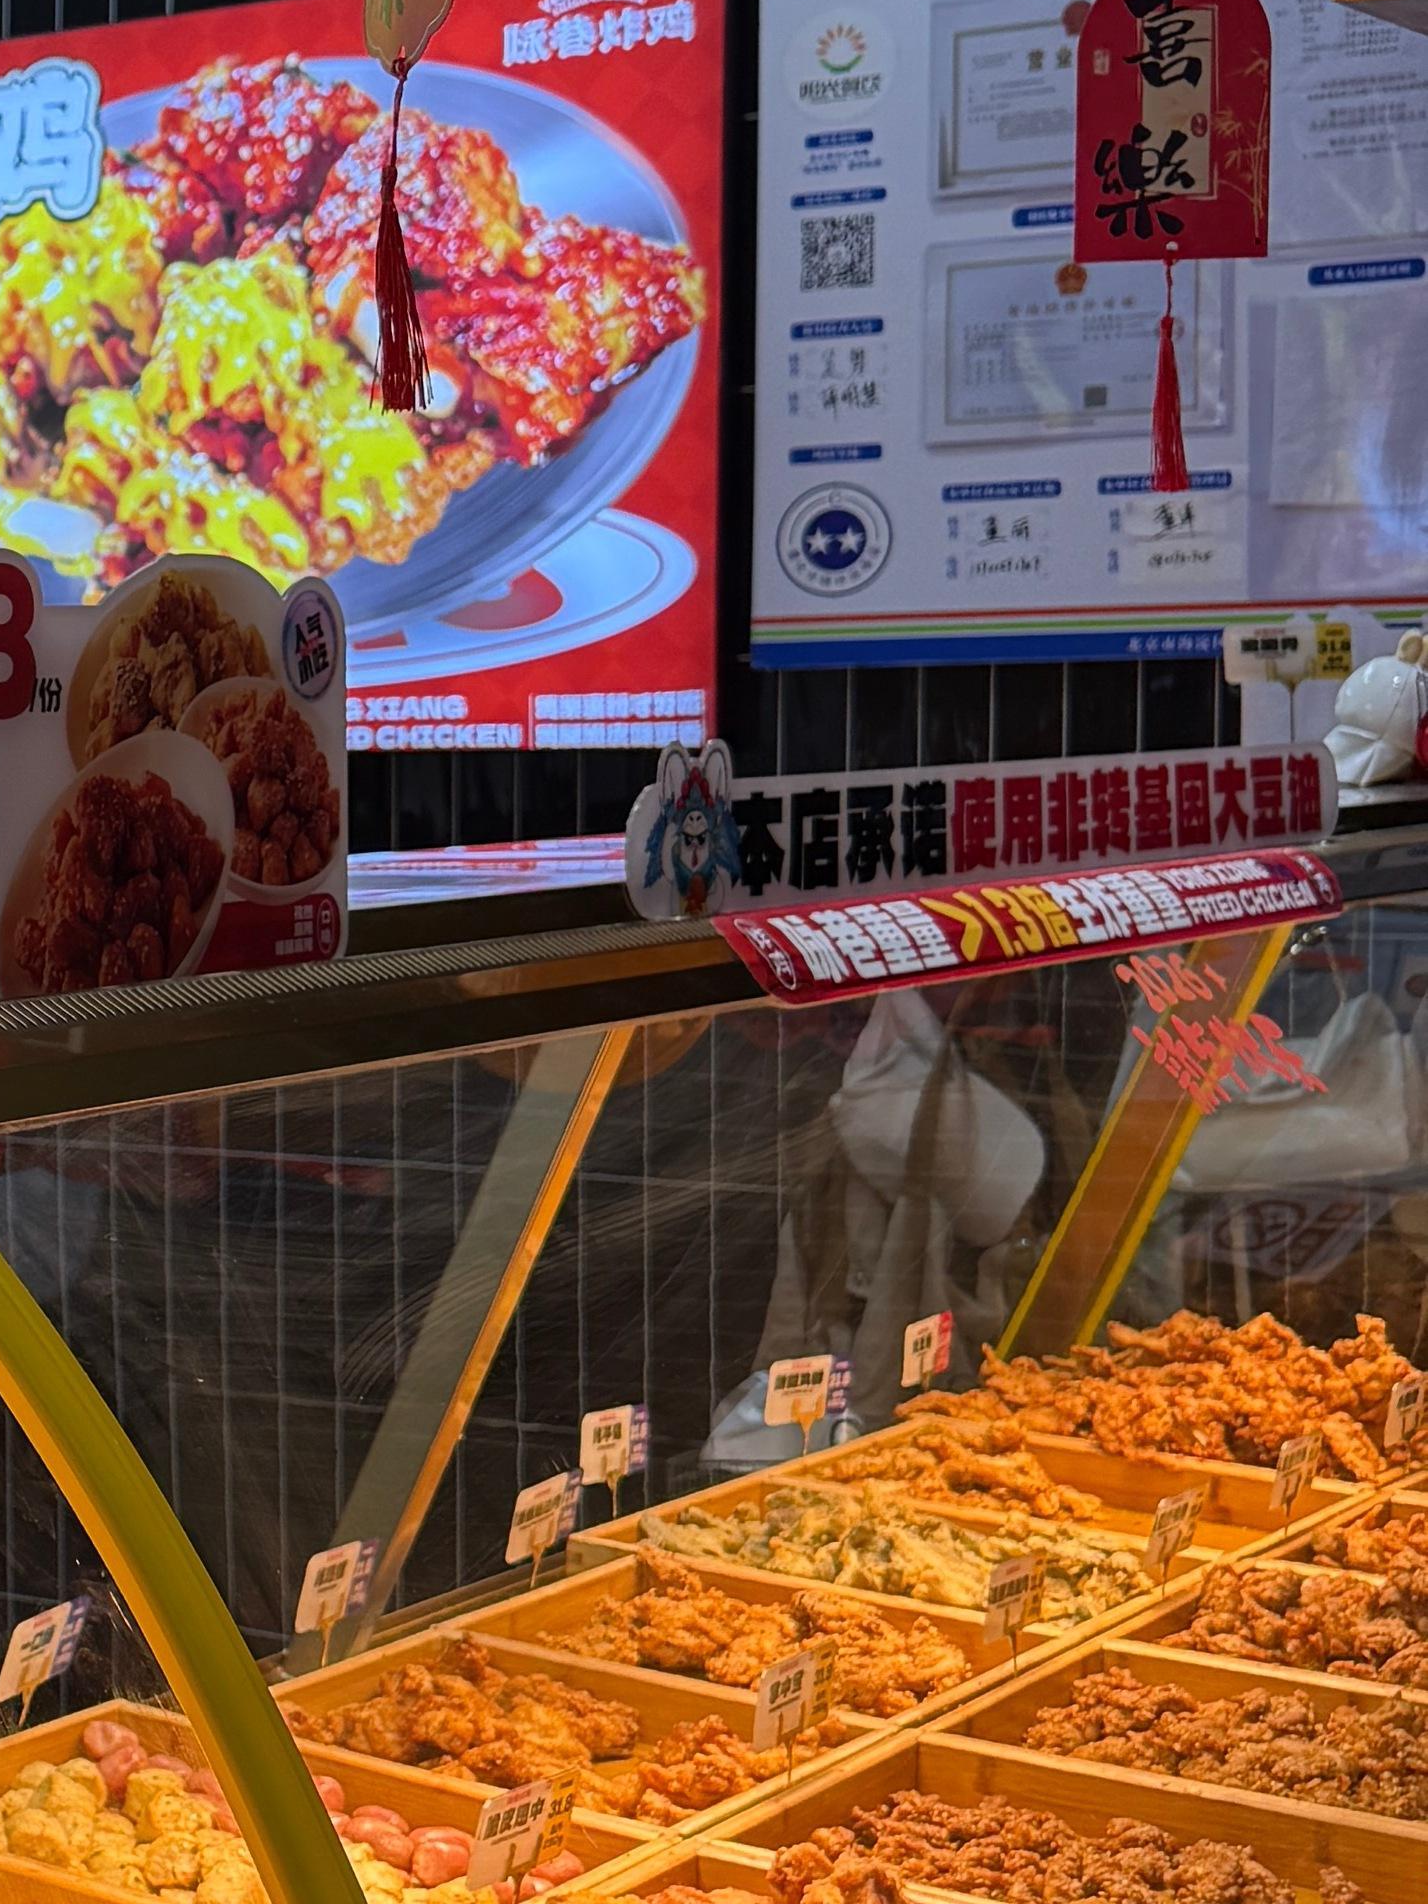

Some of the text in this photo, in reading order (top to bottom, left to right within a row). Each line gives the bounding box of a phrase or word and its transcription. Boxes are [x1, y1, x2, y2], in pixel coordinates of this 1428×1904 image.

[365, 694, 468, 722] XIANG
[375, 723, 523, 751] CHICKEN
[734, 753, 1321, 895] 本店承诺使用非转基因大豆油
[1185, 878, 1318, 924] FRIED CHICKEN
